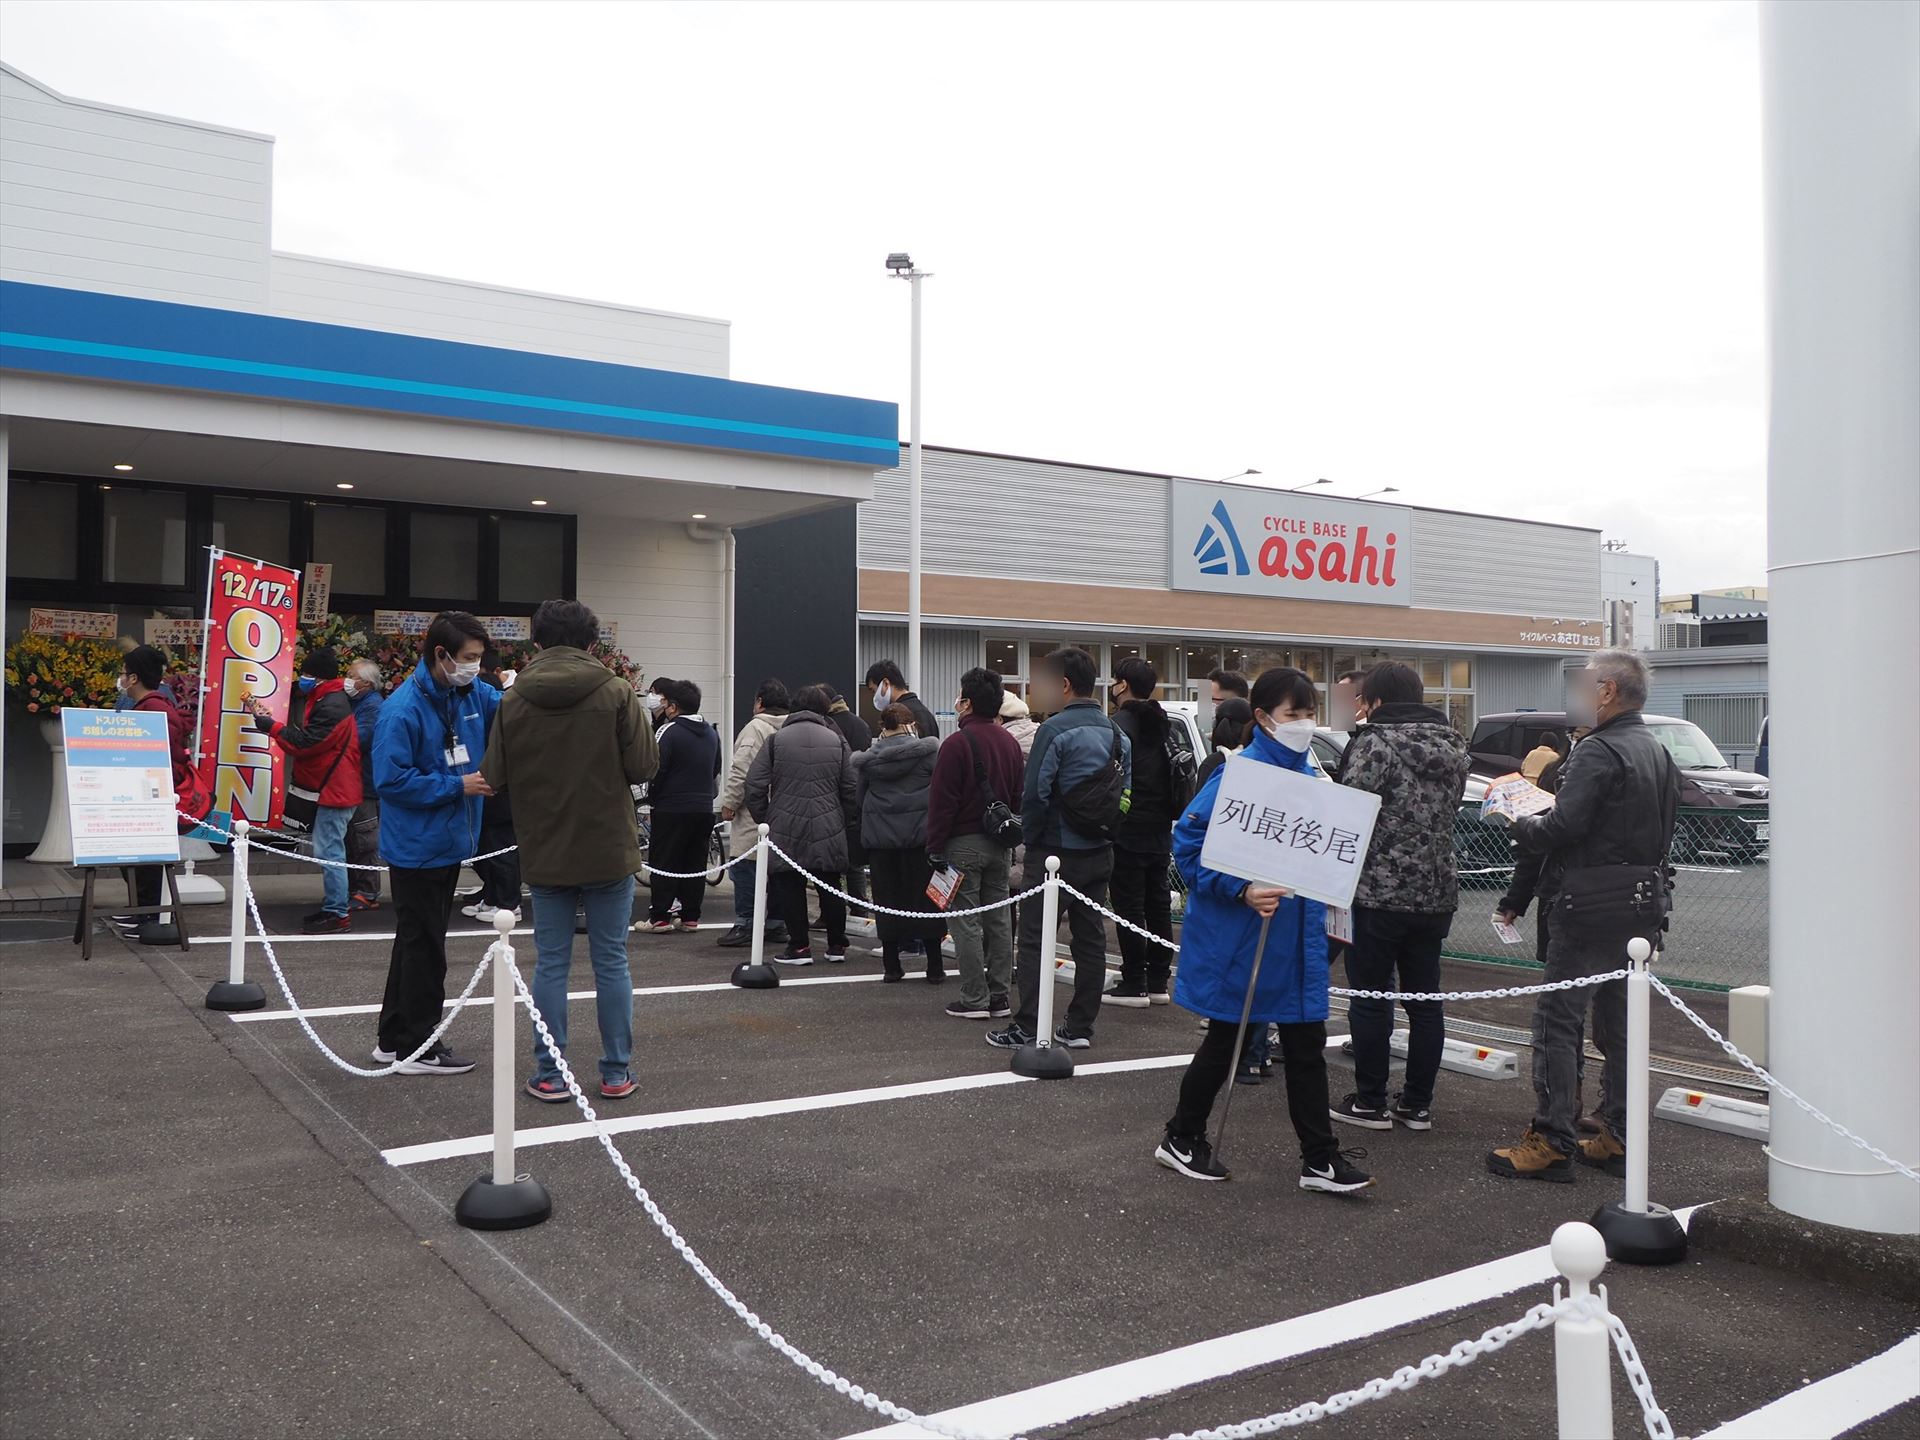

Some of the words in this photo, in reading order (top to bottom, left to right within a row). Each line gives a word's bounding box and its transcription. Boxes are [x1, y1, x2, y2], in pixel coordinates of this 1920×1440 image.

[1263, 516, 1306, 534] CYCLE
[1313, 522, 1347, 538] BASE
[1258, 526, 1397, 587] asahi
[221, 571, 286, 607] 12/17
[95, 715, 137, 726] ドスパラに
[215, 607, 283, 823] OPEN
[1217, 796, 1360, 865] 列最後尾
